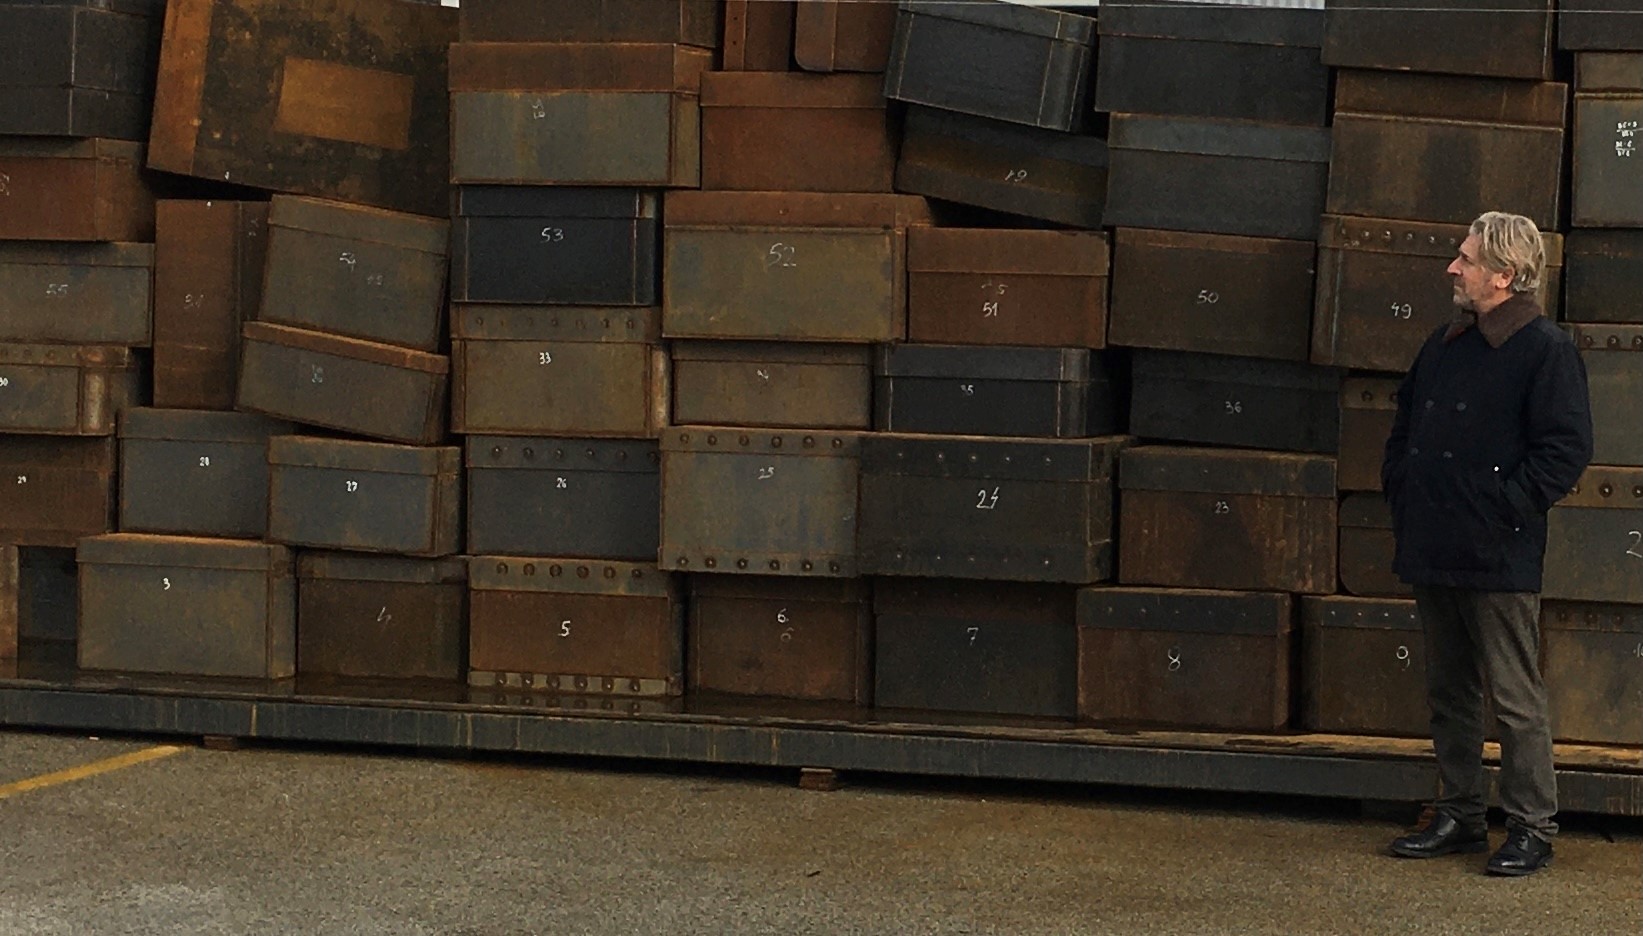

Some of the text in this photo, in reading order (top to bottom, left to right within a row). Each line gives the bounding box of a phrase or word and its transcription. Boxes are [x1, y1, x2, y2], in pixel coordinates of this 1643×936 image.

[541, 227, 564, 243] 53
[769, 242, 797, 267] 52
[1197, 289, 1219, 305] 50
[982, 302, 999, 318] 51
[1390, 302, 1412, 319] 49
[539, 352, 552, 365] 33
[1225, 401, 1243, 415] 36
[1215, 501, 1230, 514] 23
[162, 577, 171, 590] 3
[558, 620, 571, 637] 5
[966, 626, 979, 646] 7
[1167, 647, 1181, 671] 8
[1396, 645, 1411, 671] 9
